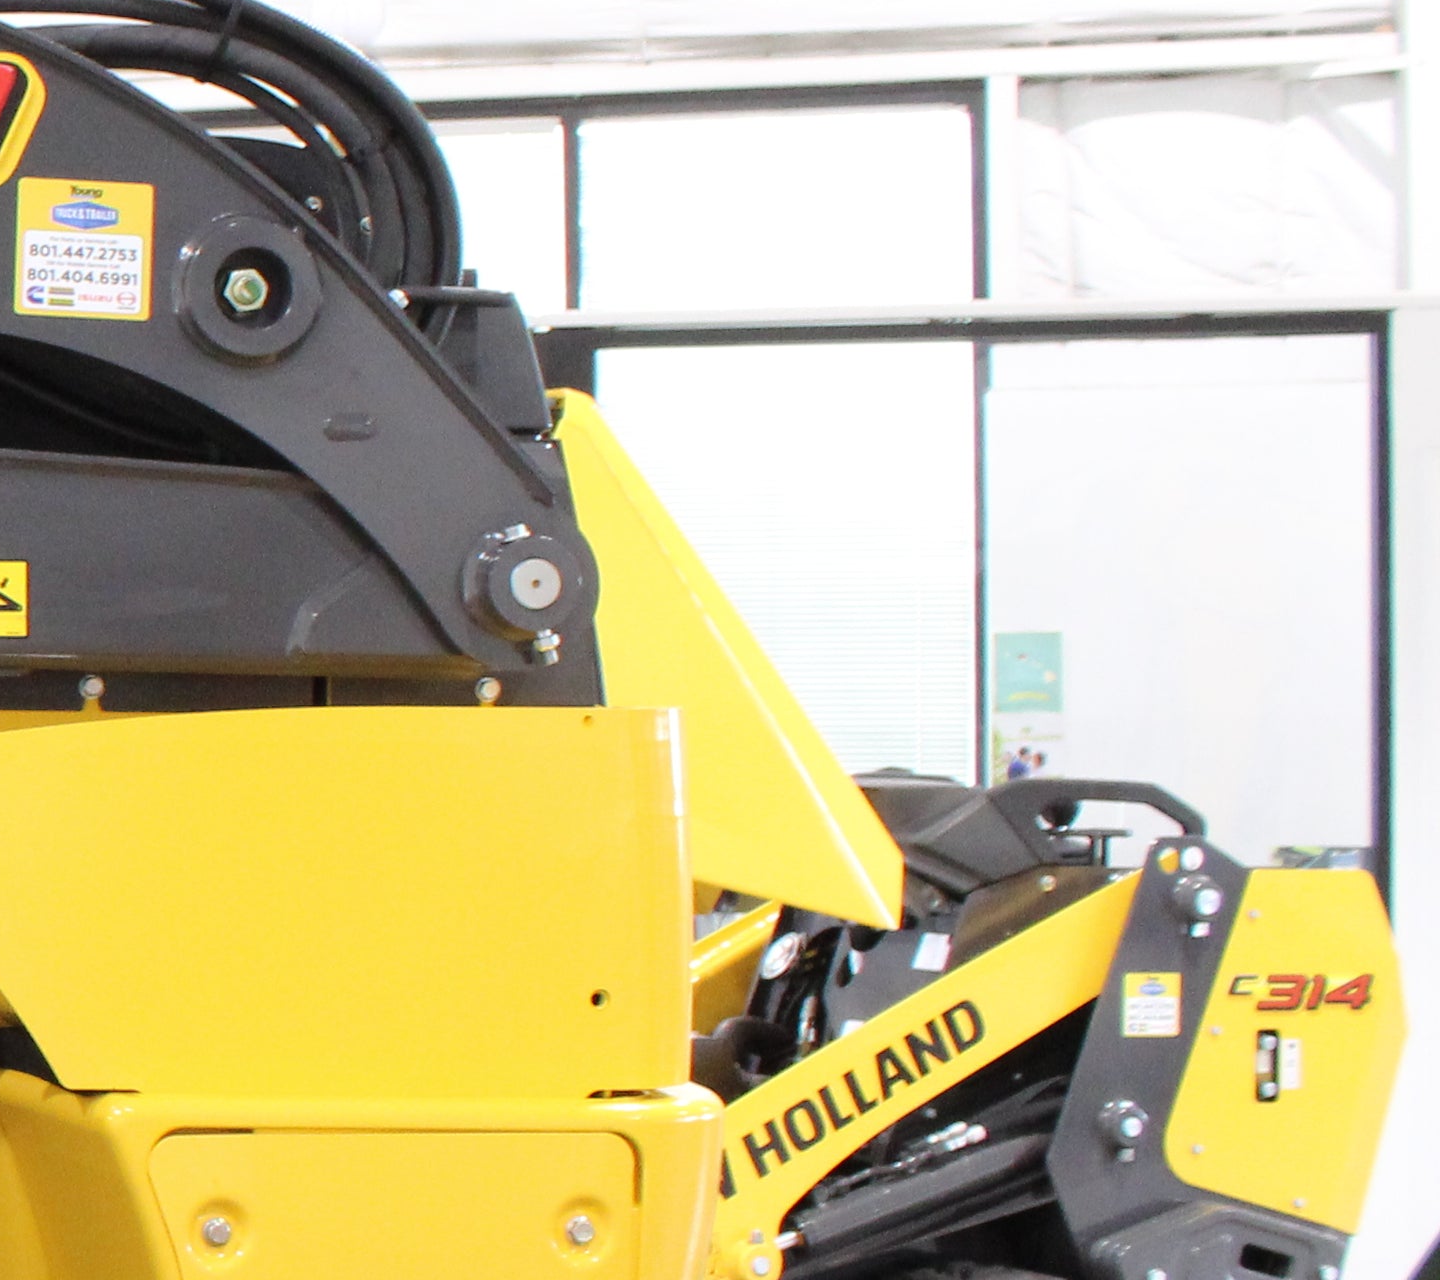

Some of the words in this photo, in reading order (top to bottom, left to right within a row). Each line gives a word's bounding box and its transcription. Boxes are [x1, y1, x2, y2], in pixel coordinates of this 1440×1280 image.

[69, 185, 103, 198] Young
[29, 244, 137, 262] 801.447.2753
[27, 268, 138, 286] 801.404.6991
[1229, 974, 1374, 1010] C314
[742, 1000, 986, 1179] HOLLAND
